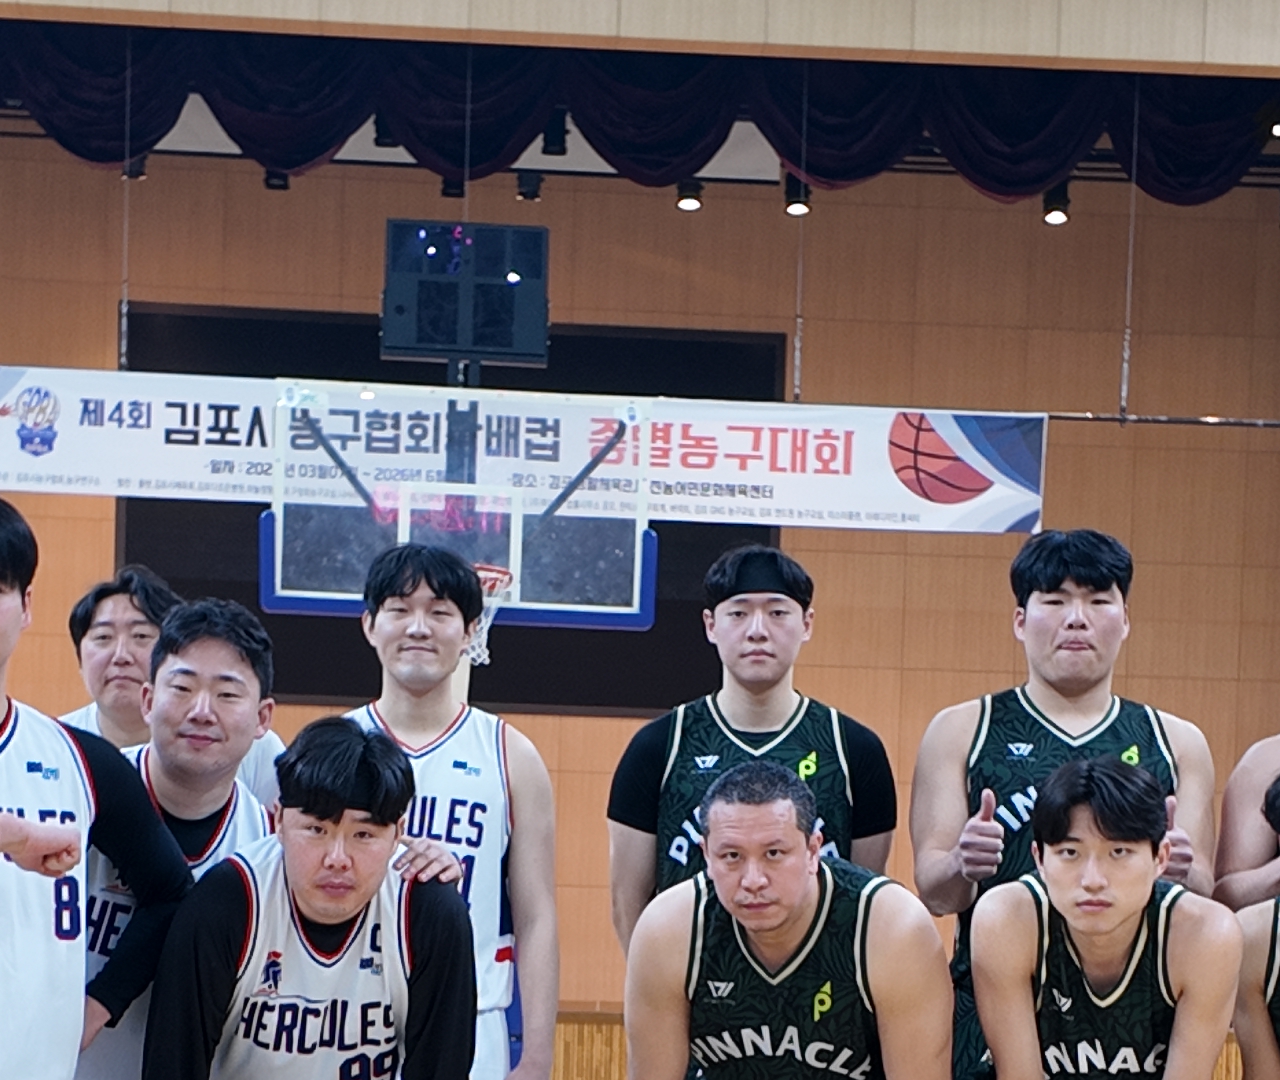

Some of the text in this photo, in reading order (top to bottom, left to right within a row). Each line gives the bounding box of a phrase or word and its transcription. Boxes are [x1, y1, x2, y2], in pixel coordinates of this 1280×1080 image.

[79, 398, 152, 429] 제4회
[407, 795, 488, 849] ULES
[54, 874, 82, 941] 8
[234, 997, 397, 1054] HERCULES
